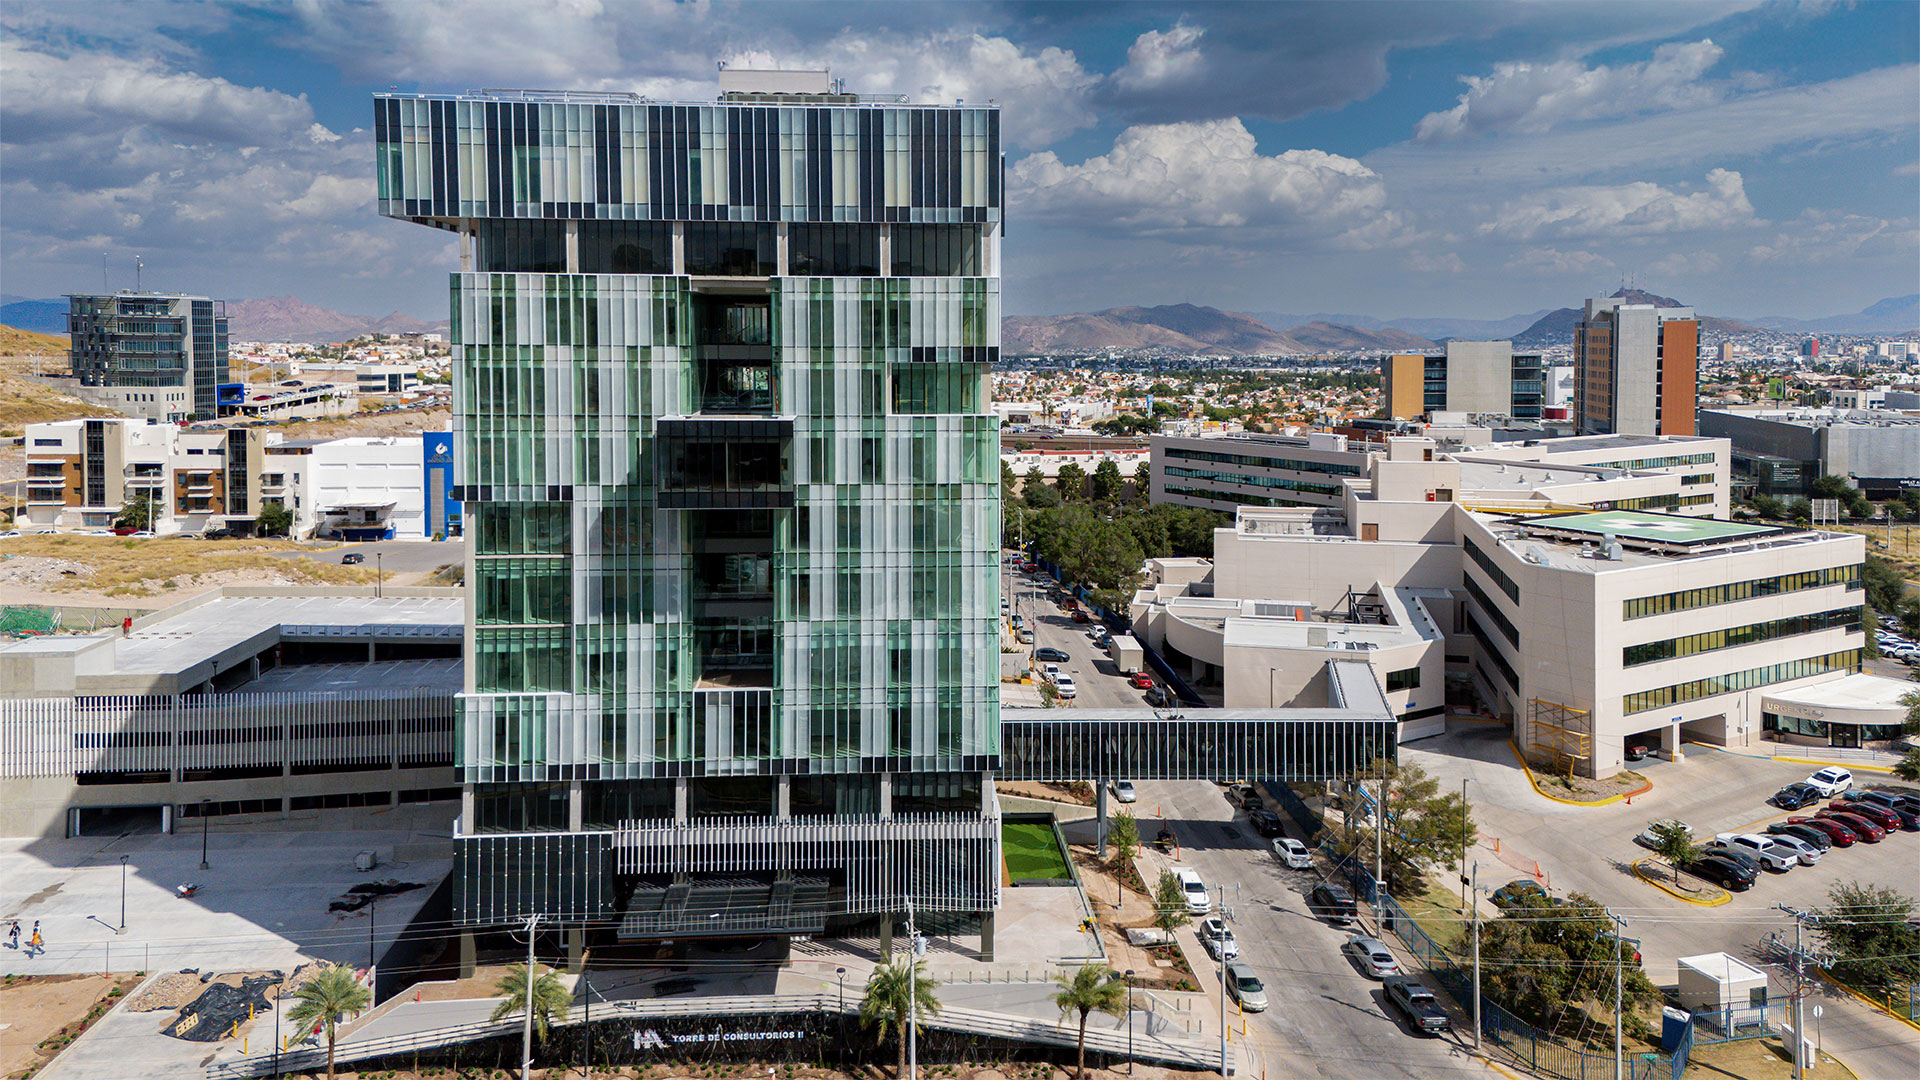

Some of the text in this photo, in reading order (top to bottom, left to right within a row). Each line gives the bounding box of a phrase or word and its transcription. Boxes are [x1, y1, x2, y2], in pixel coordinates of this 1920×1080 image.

[1766, 702, 1825, 718] URGENCIAS
[672, 1034, 705, 1042] TORRE
[707, 1034, 721, 1042] DE
[723, 1031, 795, 1041] CONSULTORIOS
